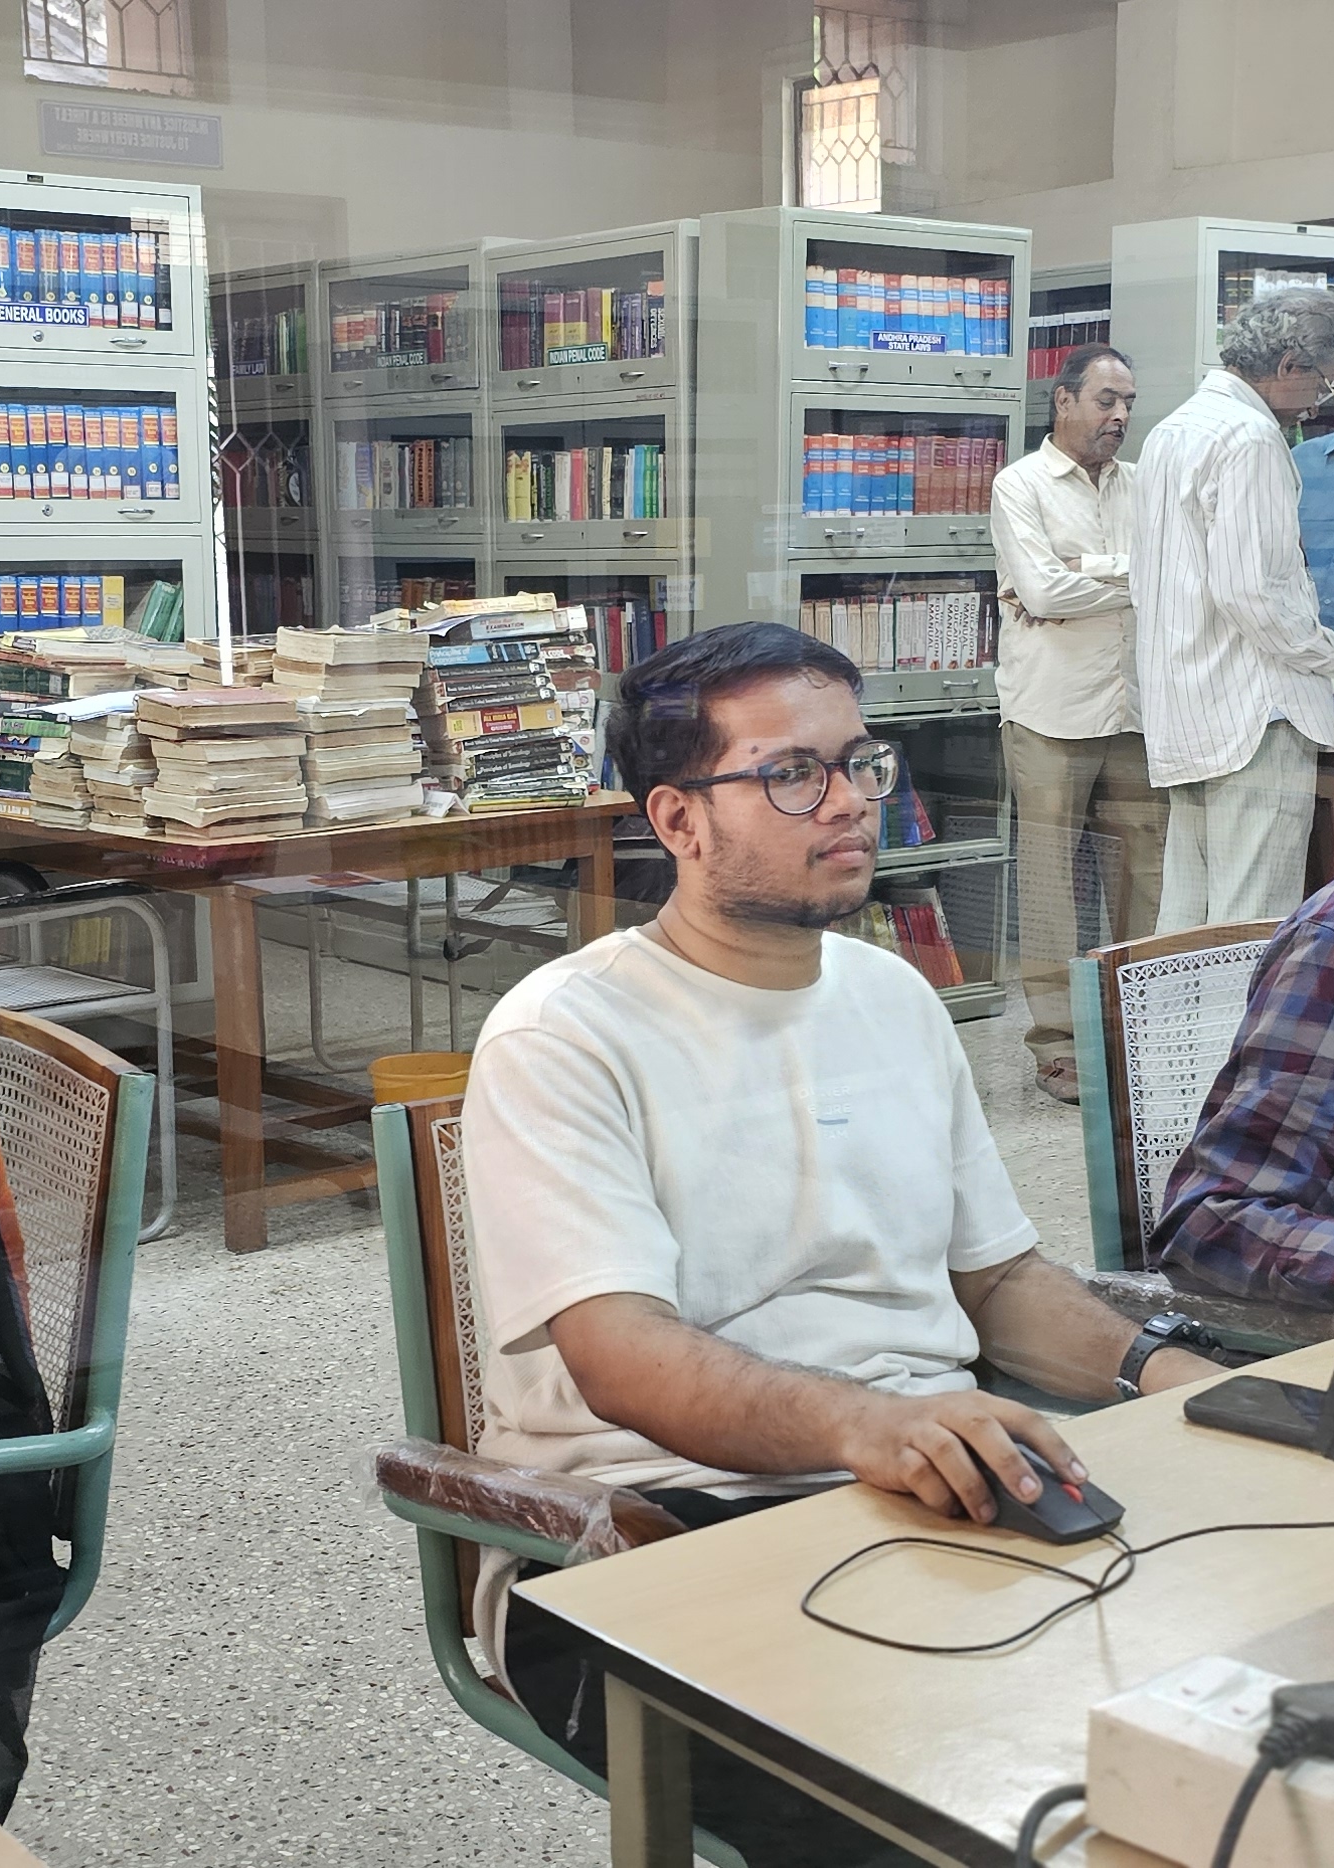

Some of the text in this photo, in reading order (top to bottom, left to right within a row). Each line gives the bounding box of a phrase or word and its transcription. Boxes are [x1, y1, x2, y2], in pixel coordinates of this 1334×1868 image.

[45, 307, 86, 326] BOOKS
[877, 333, 942, 345] ANDHRA PRADESH
[888, 342, 932, 352] STATE LAWS
[376, 352, 425, 368] INDIAN PENAL CODE
[549, 347, 606, 365] INDIAN PENAL CODE
[485, 621, 525, 631] EXAMINATION
[927, 604, 935, 652] MANUAL
[945, 604, 954, 651] MANUAL
[962, 603, 970, 650] MANUAL
